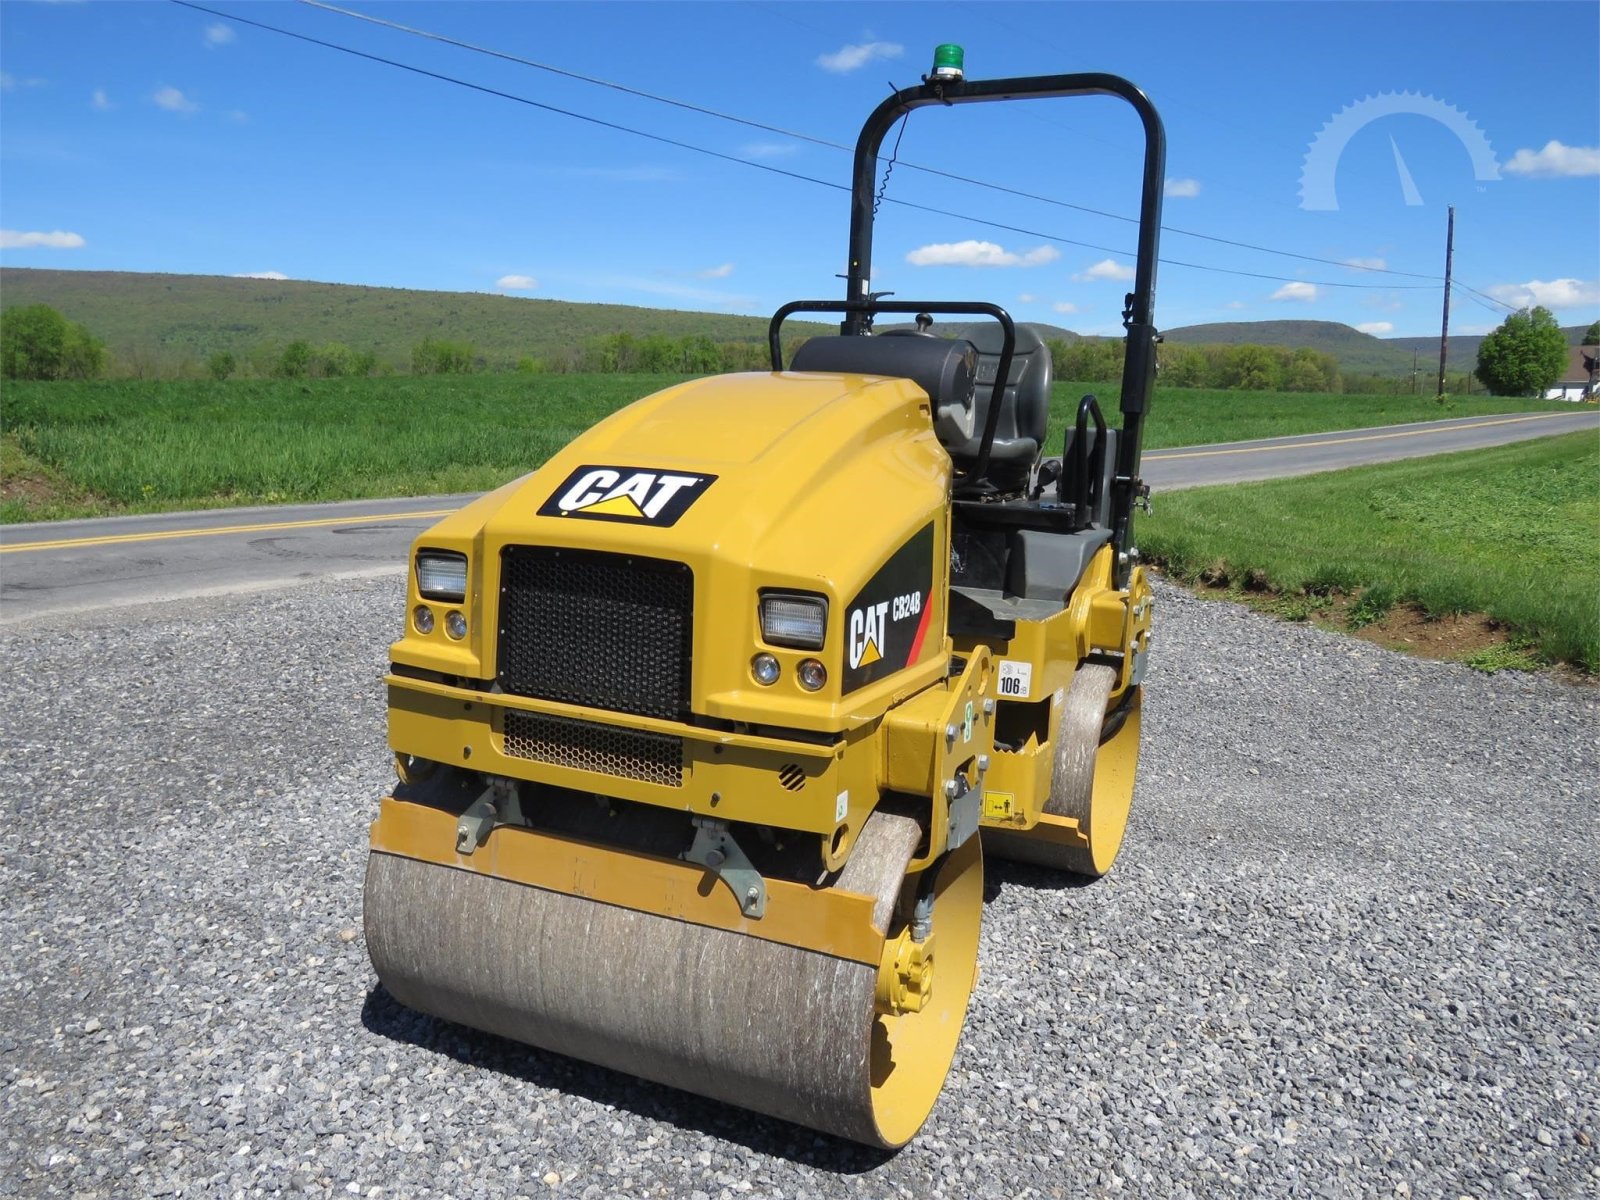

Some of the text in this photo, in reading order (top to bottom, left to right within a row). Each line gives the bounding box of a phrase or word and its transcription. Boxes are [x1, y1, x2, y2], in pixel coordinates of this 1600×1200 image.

[558, 470, 699, 518] CAT
[849, 591, 920, 669] CAT CB24B
[1001, 676, 1020, 694] 106
